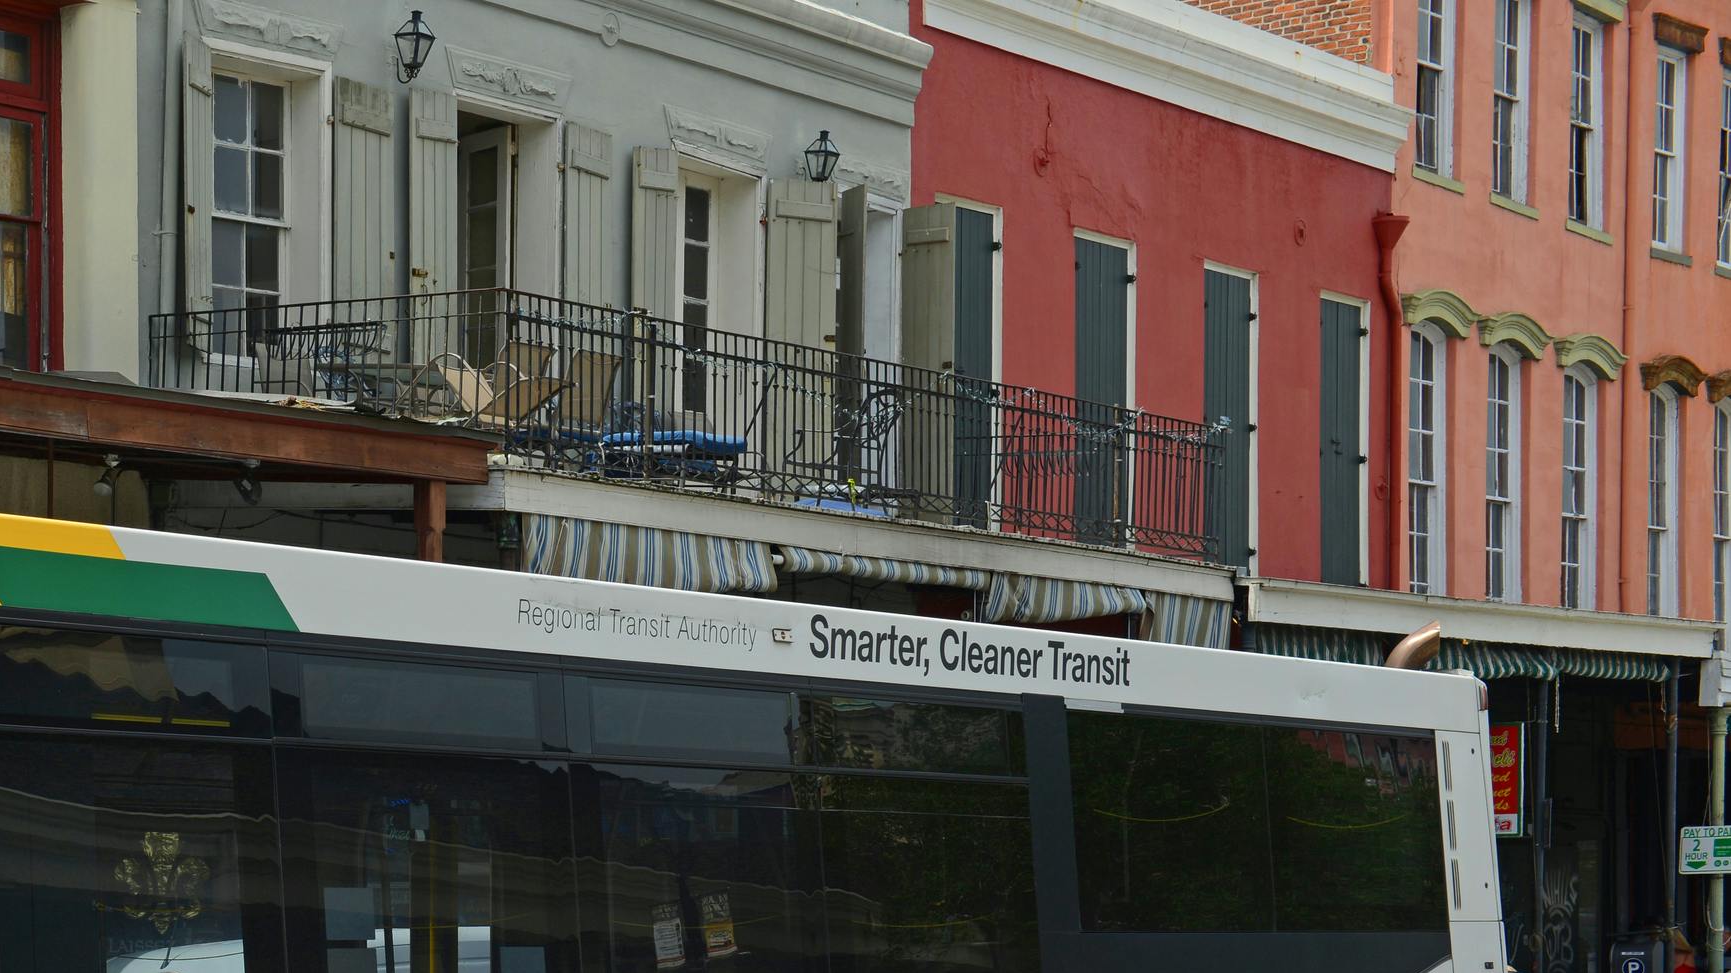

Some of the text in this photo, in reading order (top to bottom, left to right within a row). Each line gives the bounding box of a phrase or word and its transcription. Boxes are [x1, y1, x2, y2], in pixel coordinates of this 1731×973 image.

[517, 598, 757, 652] Regional Transit Authority
[809, 613, 1131, 687] Smarter, Cleaner Transit
[1491, 747, 1517, 768] eli
[1683, 827, 1731, 838] PAY TO PA
[1692, 839, 1701, 851] 2
[1685, 852, 1708, 860] HOUR
